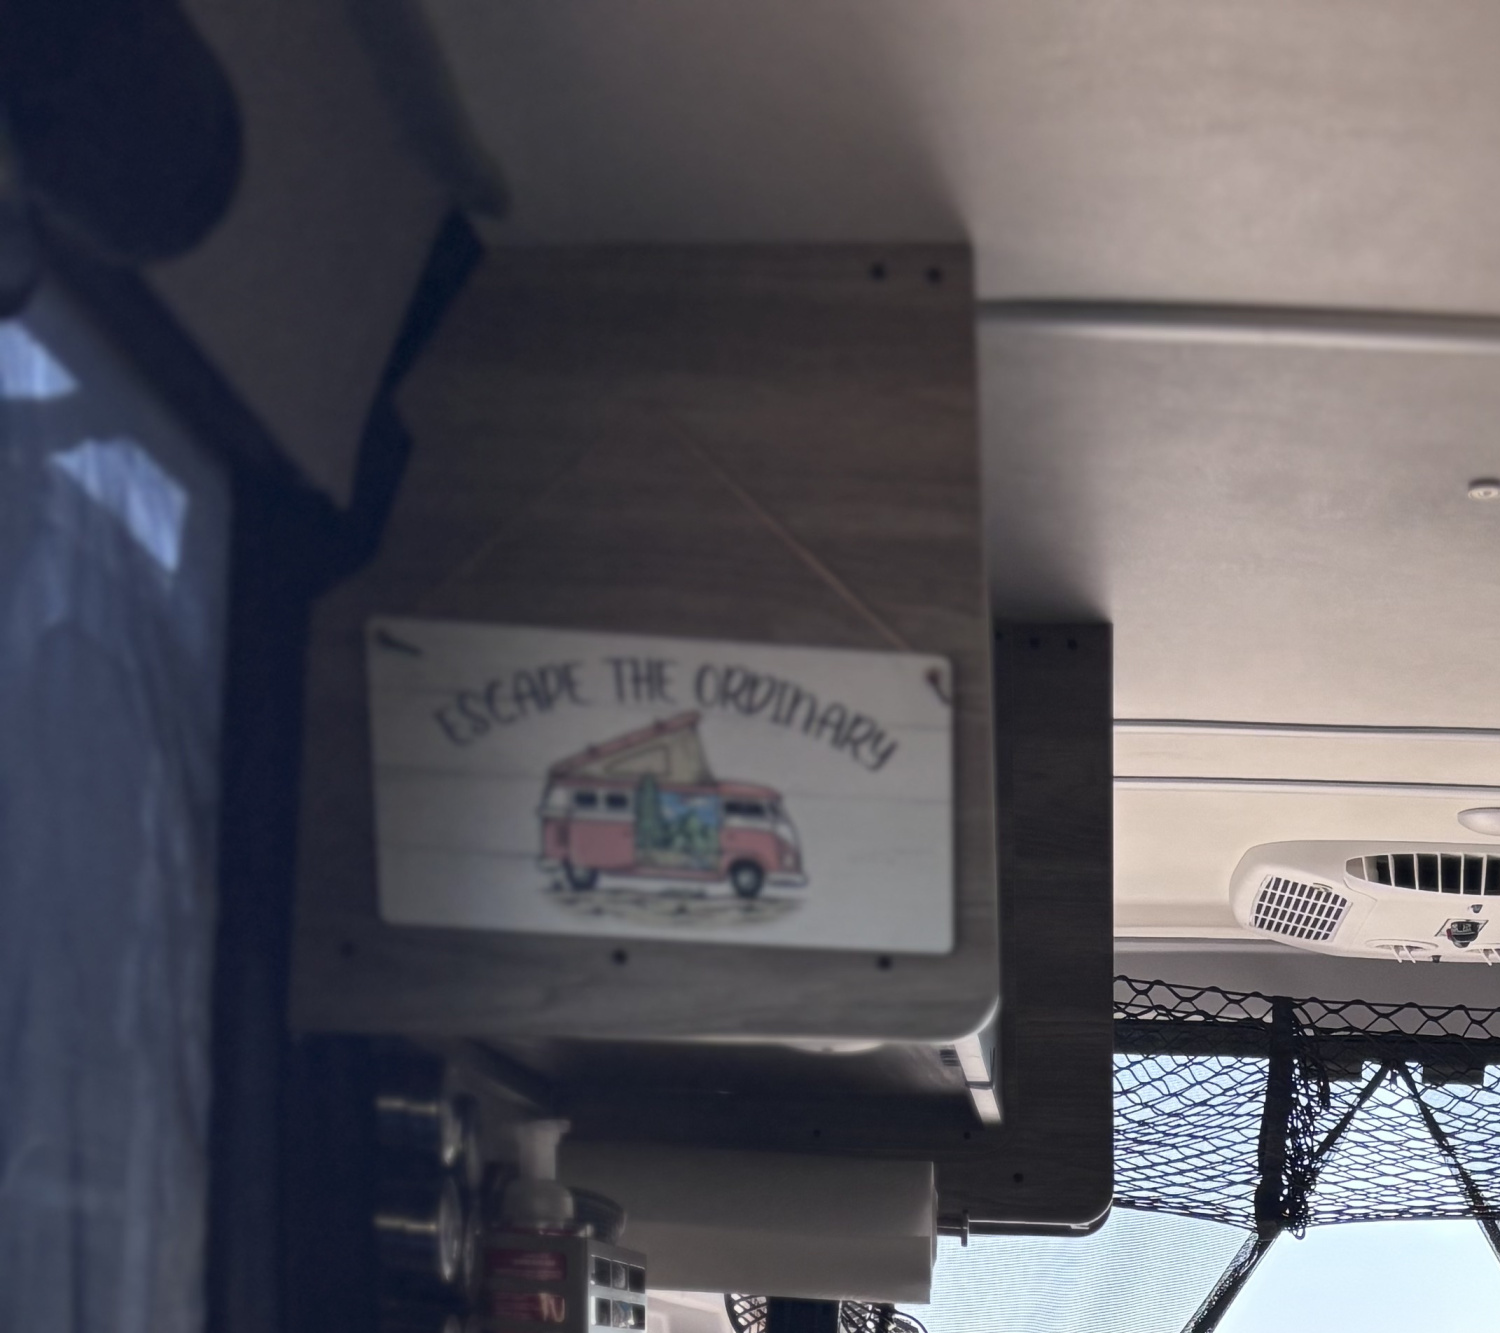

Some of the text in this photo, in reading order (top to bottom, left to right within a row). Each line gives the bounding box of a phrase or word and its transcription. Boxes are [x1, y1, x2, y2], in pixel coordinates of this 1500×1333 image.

[433, 656, 899, 773] ESCAPE THE ORDINARY
